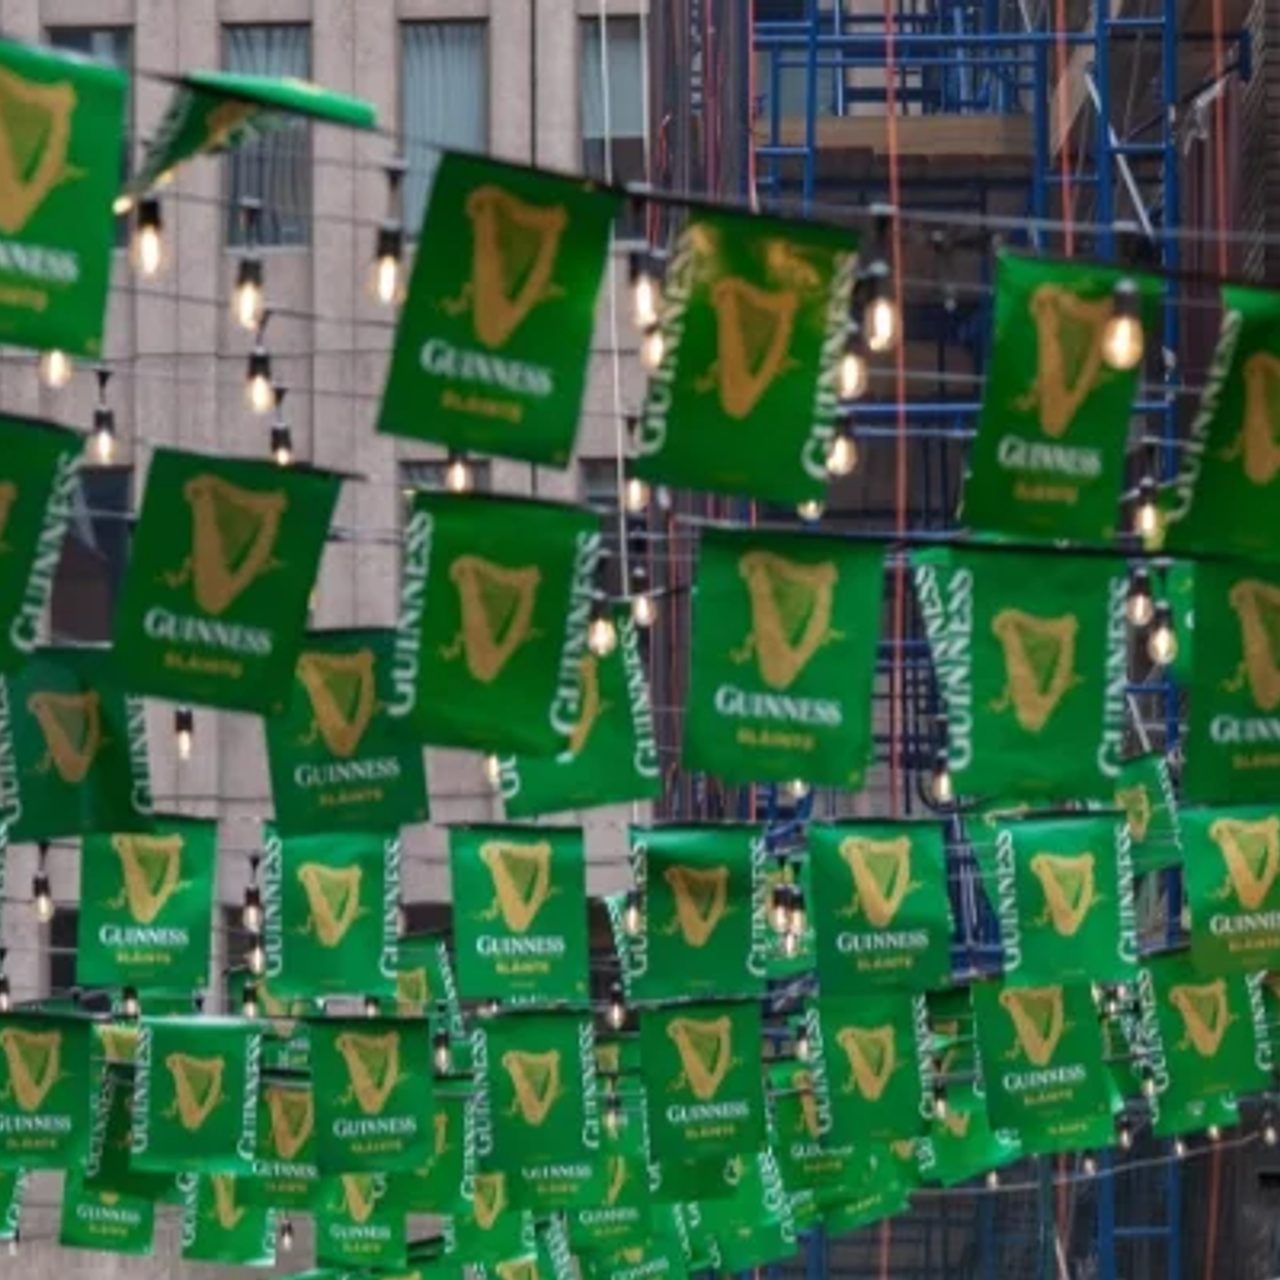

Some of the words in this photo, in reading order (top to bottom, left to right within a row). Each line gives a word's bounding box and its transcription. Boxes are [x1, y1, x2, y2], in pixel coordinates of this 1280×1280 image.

[420, 338, 553, 396] GUINNESS
[998, 434, 1102, 478] GUINNESS
[10, 450, 82, 653] GUINNESS
[388, 511, 434, 718] GUINNESS
[143, 608, 273, 656] GUINNESS
[550, 531, 602, 735] GUINNESS
[947, 570, 973, 771] GUINNESS
[714, 685, 842, 726] GUINNESS
[294, 756, 400, 787] GUINNESS
[99, 924, 189, 946] GUINNESS
[265, 837, 283, 978] GUINNESS
[380, 839, 402, 978] GUINNESS
[476, 934, 566, 955] GUINNESS
[747, 836, 768, 977] GUINNESS
[837, 931, 929, 954] GUINNESS
[995, 829, 1020, 971] GUINNESS
[1115, 823, 1138, 963] GUINNESS
[131, 1027, 152, 1153] GUINNESS
[238, 1034, 262, 1160] GUINNESS
[333, 1114, 417, 1138] GUINNESS
[578, 1022, 599, 1149] GUINNESS
[666, 1102, 749, 1123] GUINNESS
[1002, 1066, 1087, 1092] GUINNESS
